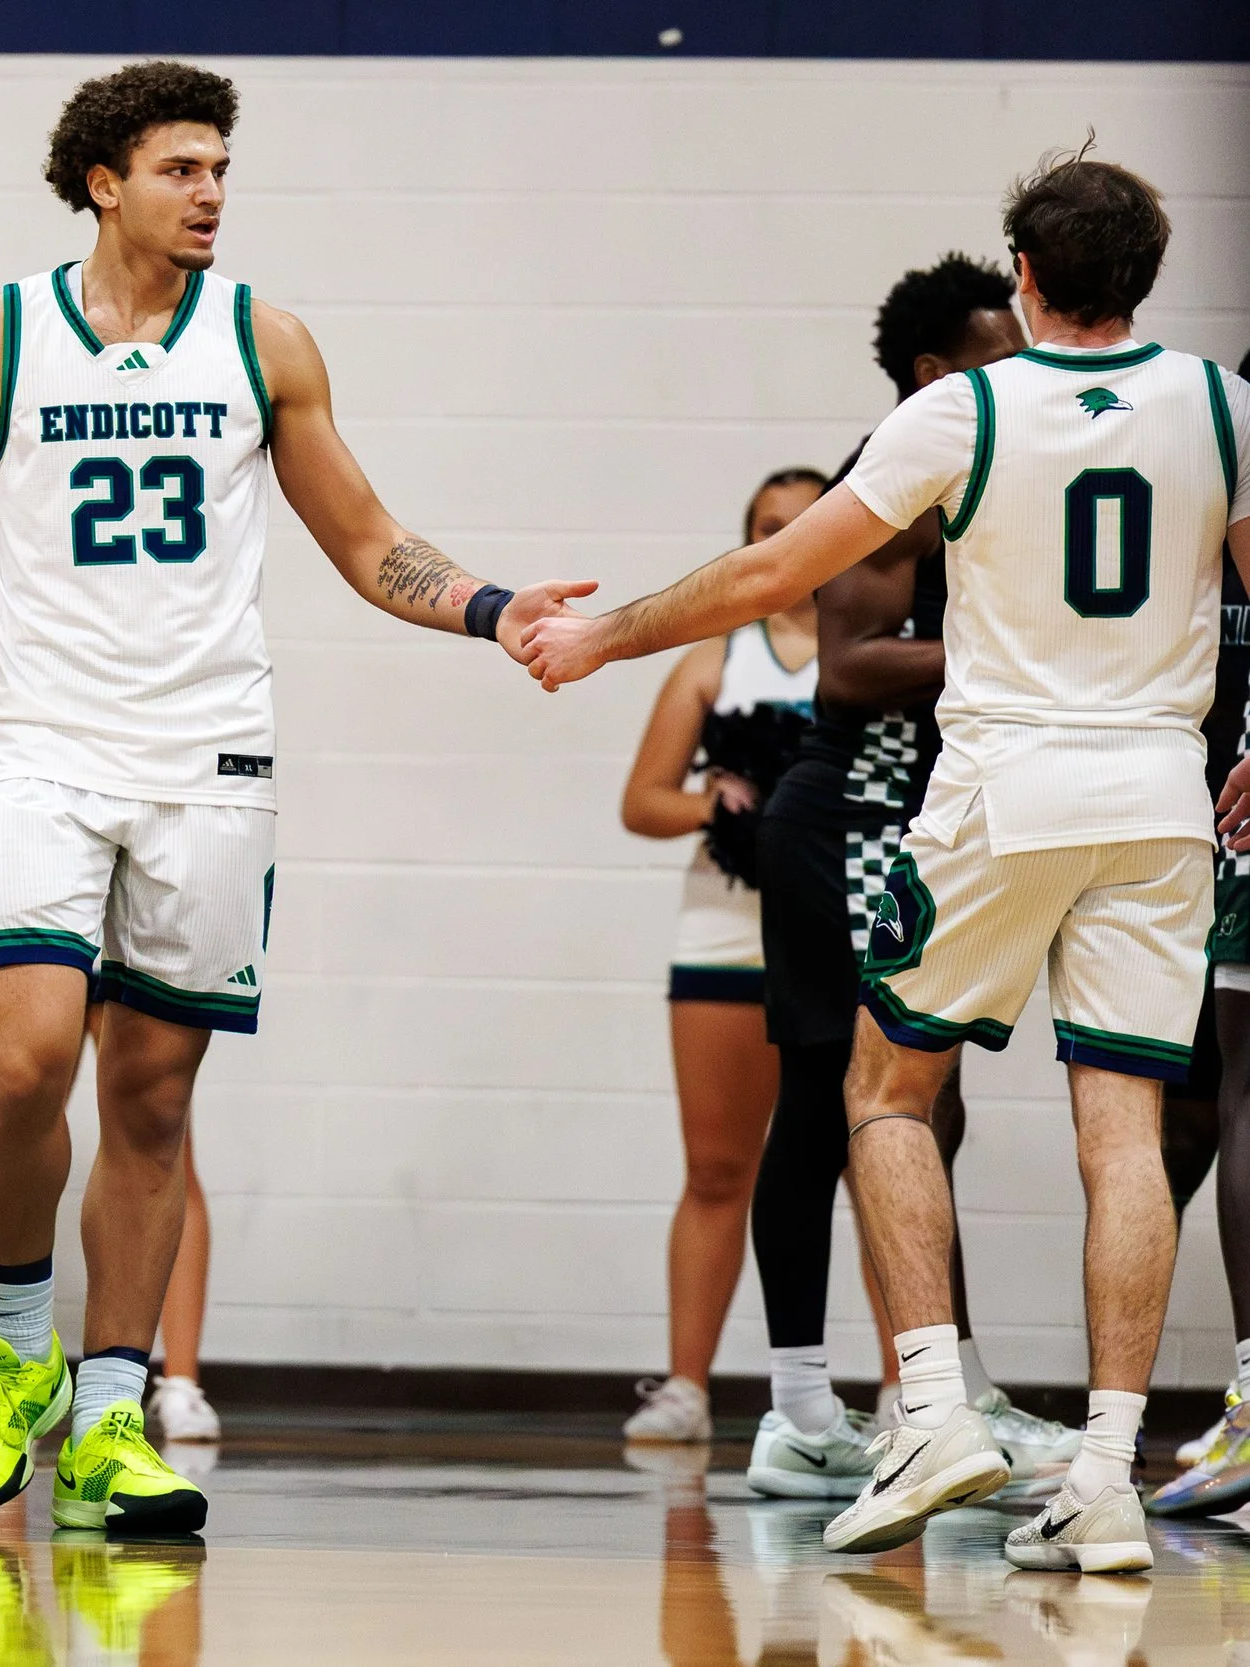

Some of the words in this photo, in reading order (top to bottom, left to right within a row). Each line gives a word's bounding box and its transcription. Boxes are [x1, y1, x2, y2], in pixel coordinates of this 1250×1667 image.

[39, 402, 228, 443] ENDICOTT
[70, 455, 207, 567] 23
[1064, 467, 1153, 618] 0
